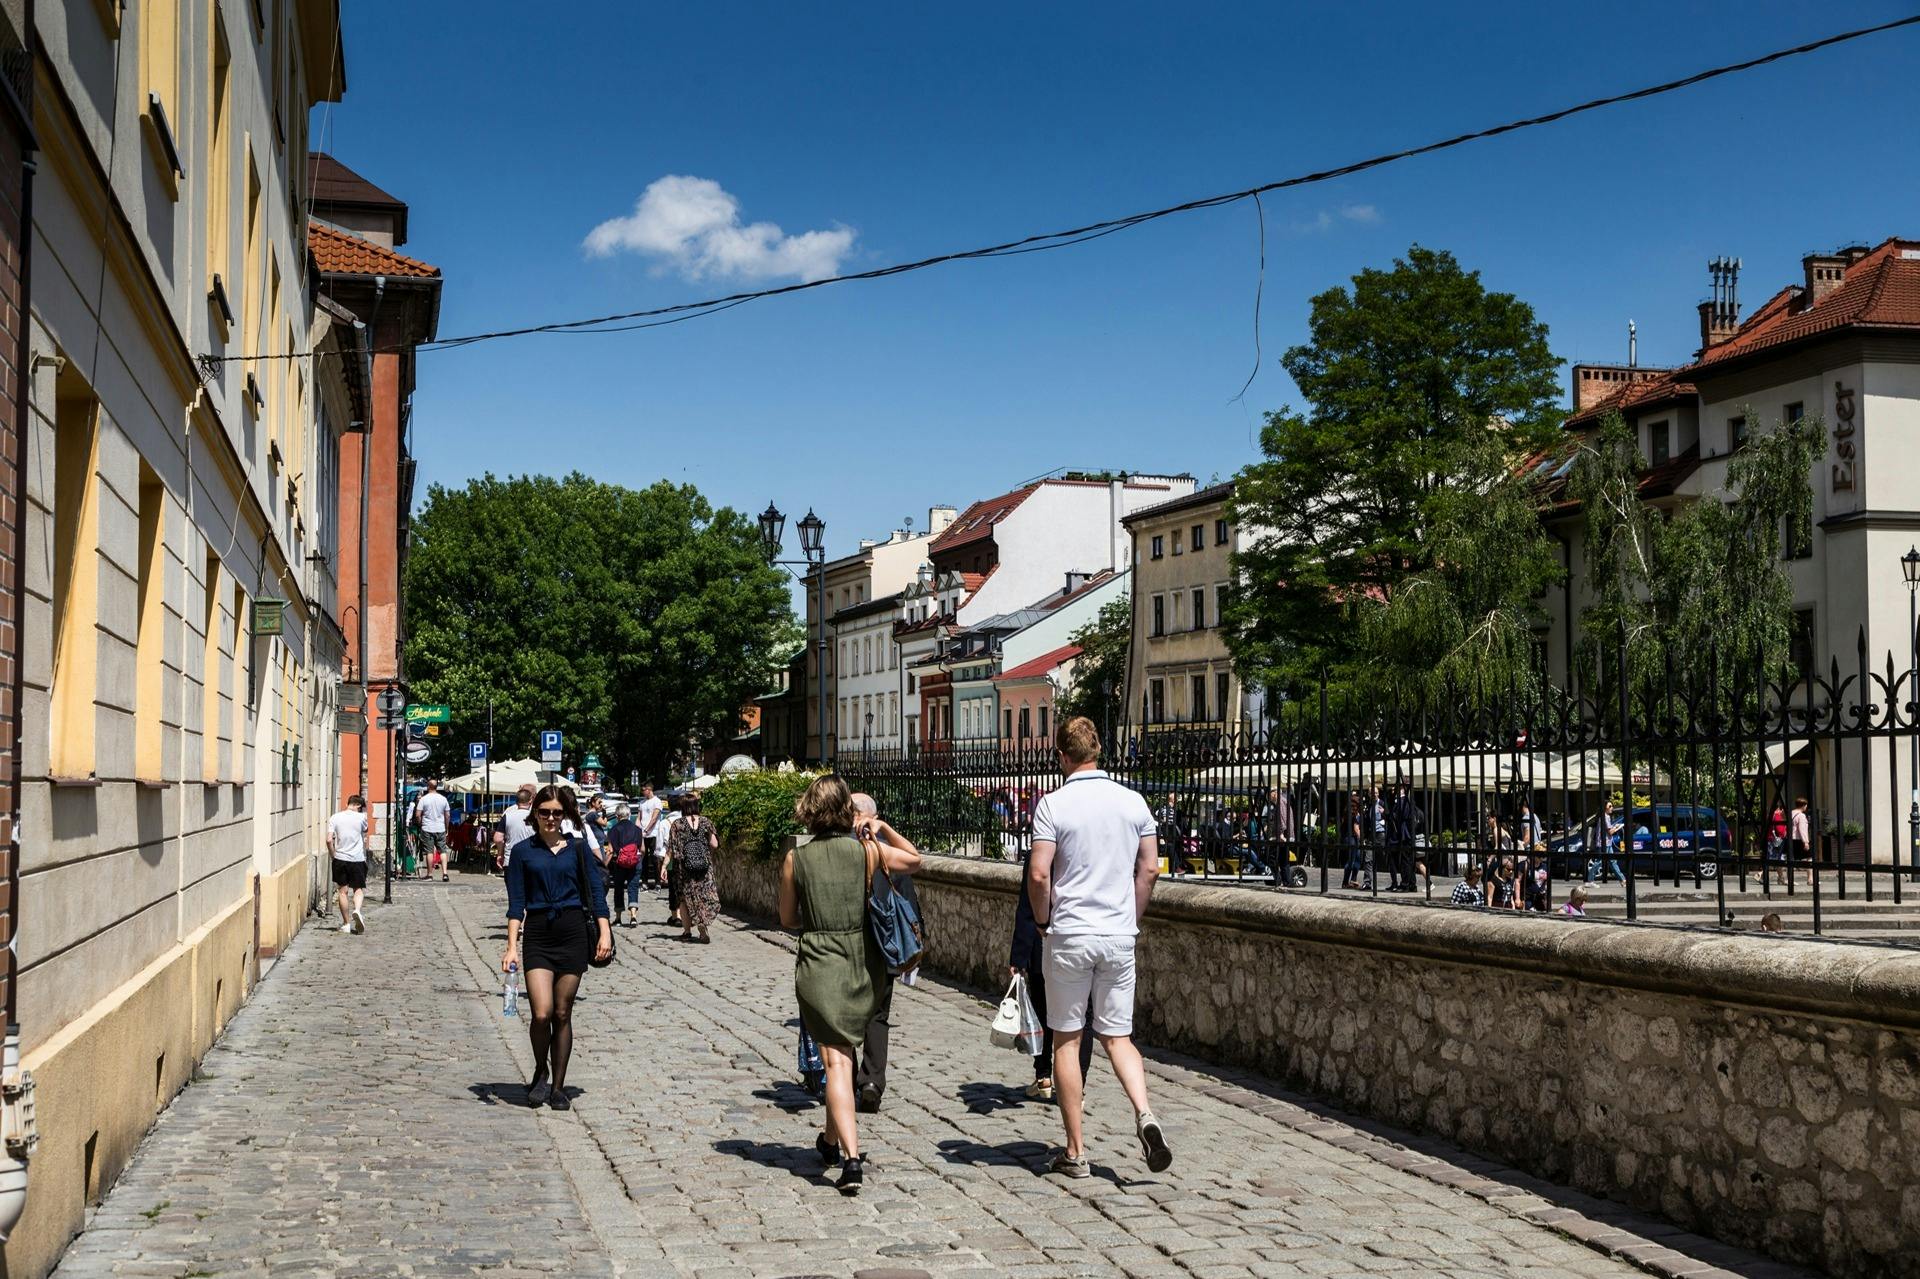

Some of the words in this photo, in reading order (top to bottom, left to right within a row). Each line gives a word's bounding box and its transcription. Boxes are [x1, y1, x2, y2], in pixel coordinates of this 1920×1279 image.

[1832, 381, 1856, 494] Ester
[546, 733, 558, 749] P
[473, 745, 483, 757] P
